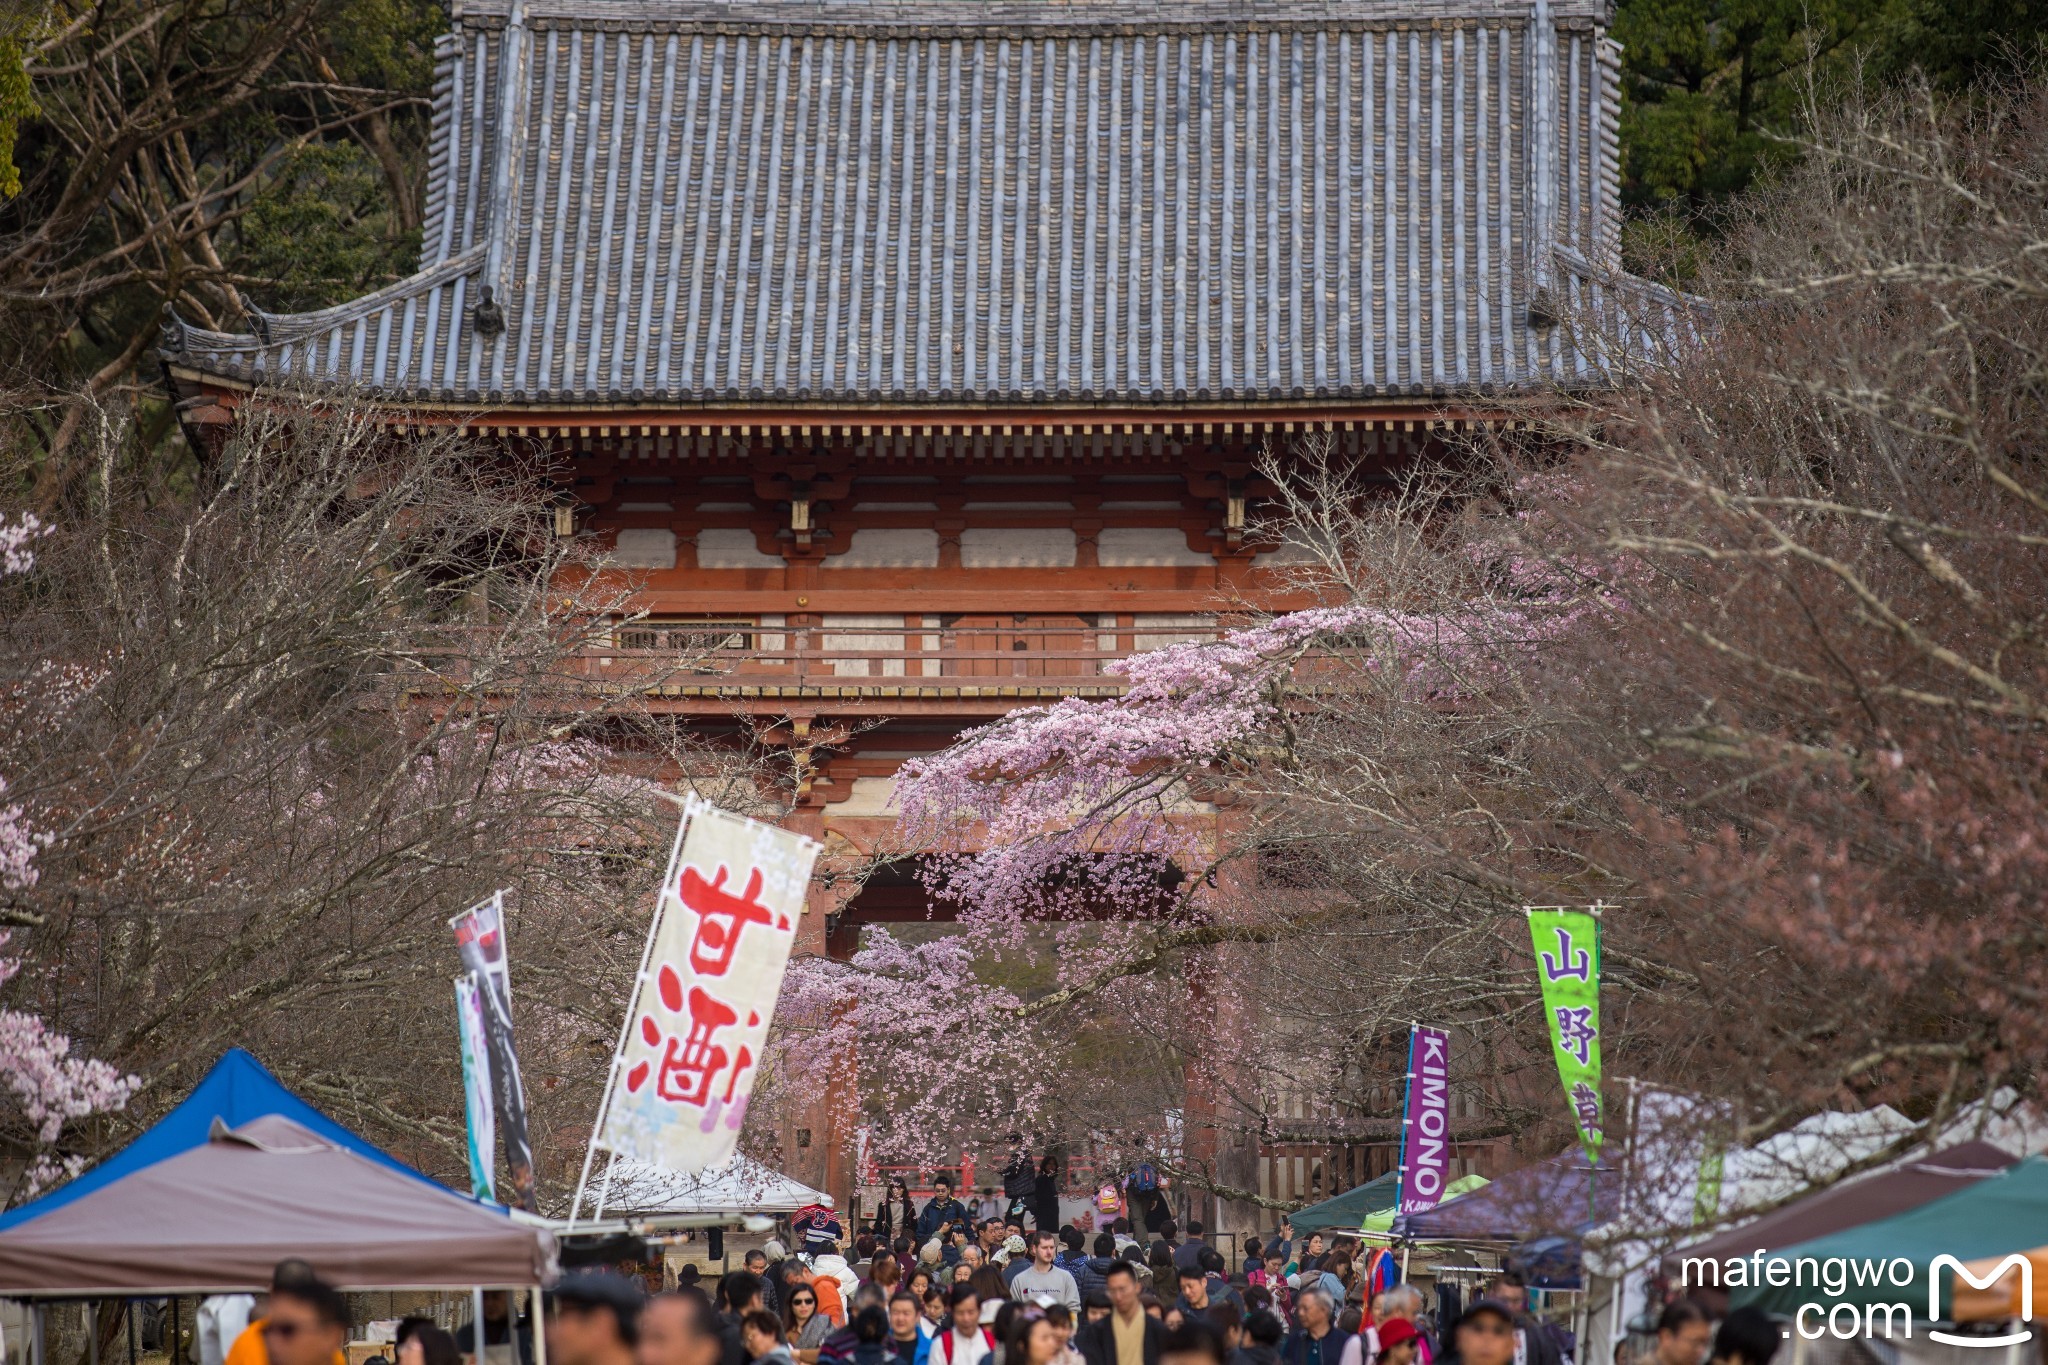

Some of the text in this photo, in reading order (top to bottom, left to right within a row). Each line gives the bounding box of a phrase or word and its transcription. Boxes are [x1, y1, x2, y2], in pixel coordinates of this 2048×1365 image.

[627, 867, 790, 1107] 甘酒
[1541, 928, 1603, 1141] 山野草
[1415, 1036, 1445, 1197] KIMONO
